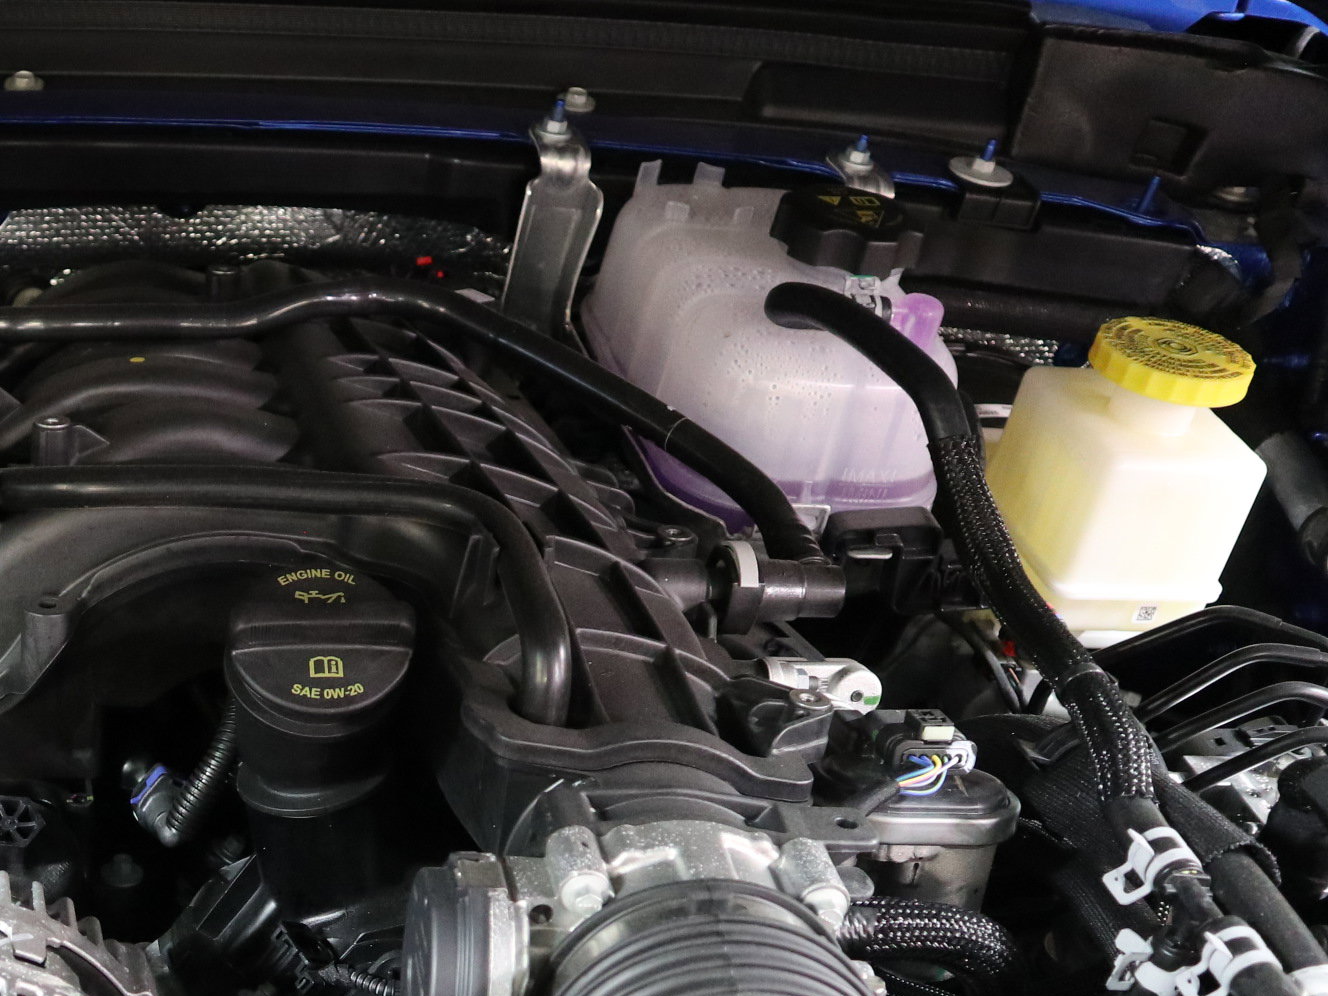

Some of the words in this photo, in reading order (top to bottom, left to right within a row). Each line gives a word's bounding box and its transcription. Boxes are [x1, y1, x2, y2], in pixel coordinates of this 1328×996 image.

[277, 568, 331, 586] ENGINE
[334, 571, 356, 585] OIL
[291, 683, 321, 699] SAE
[323, 683, 364, 699] 0W-20
